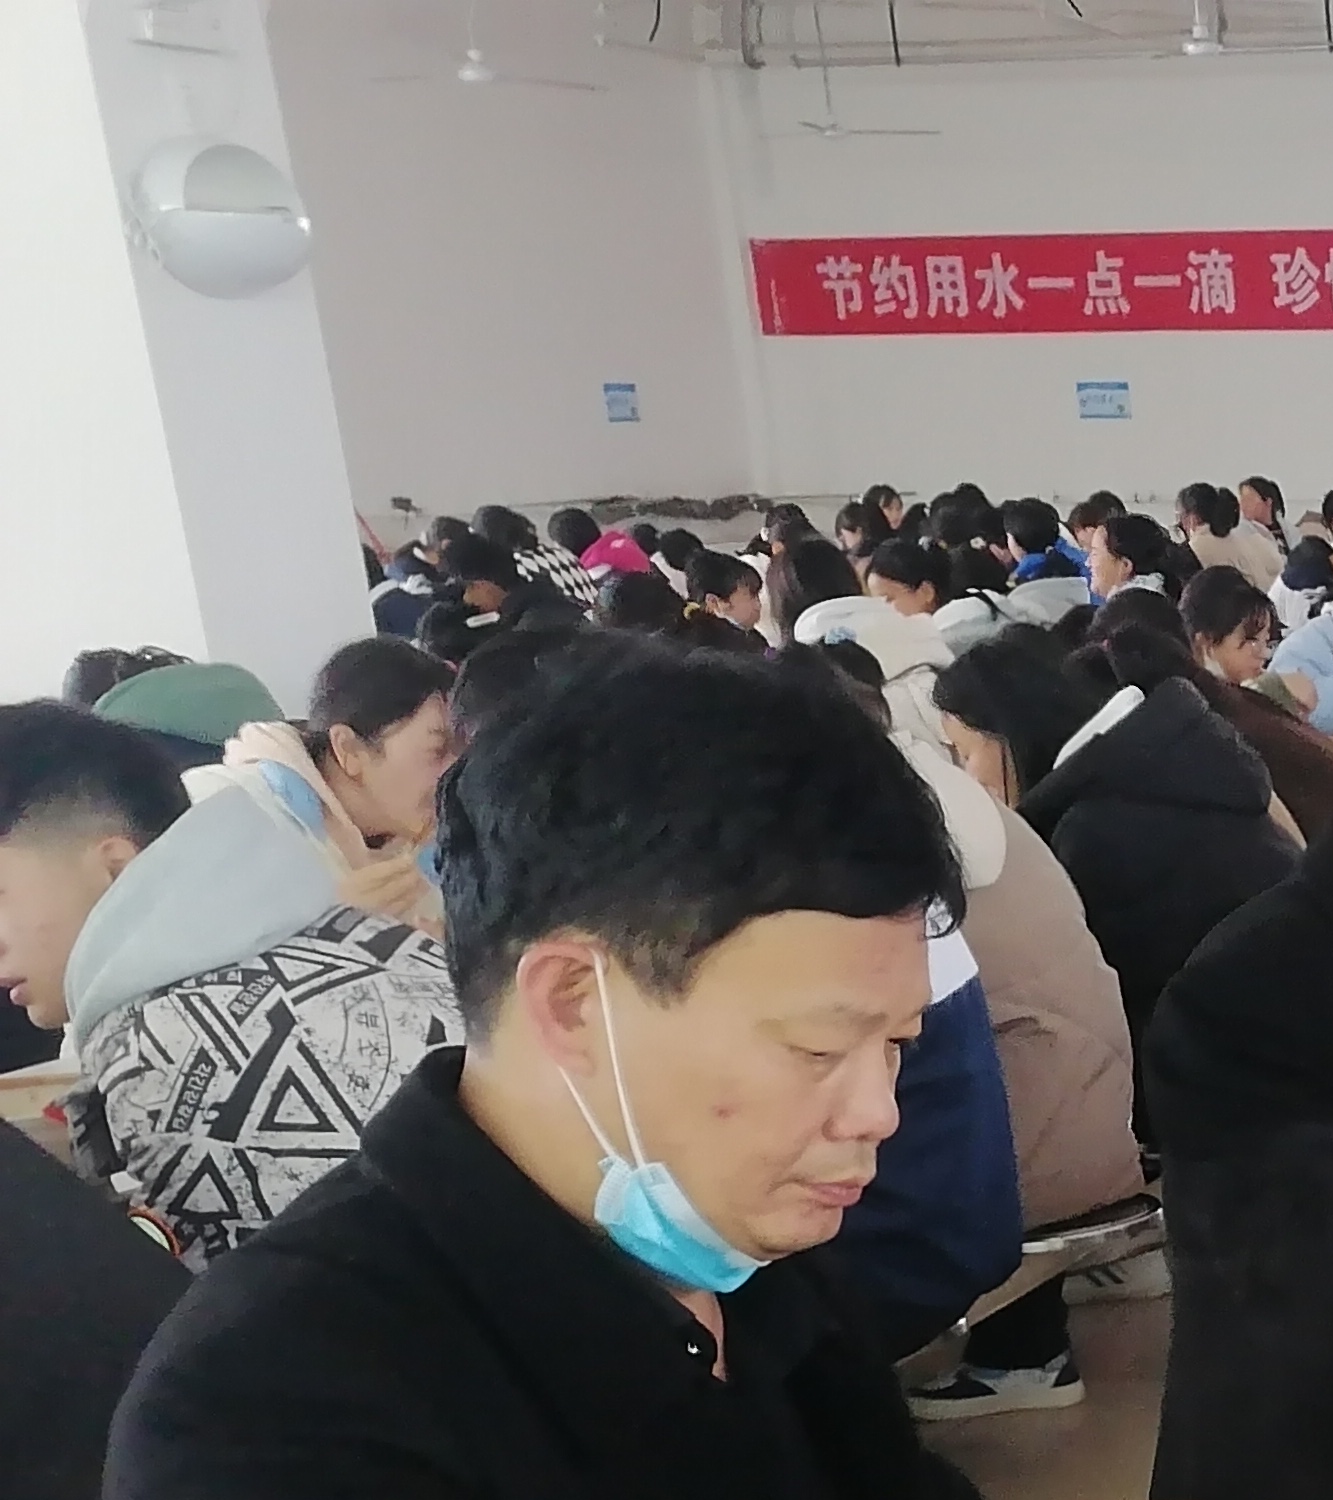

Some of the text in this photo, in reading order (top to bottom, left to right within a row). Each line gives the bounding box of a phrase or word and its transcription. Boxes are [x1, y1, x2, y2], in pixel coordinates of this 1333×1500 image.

[815, 249, 1236, 320] 节约用水一点一滴
